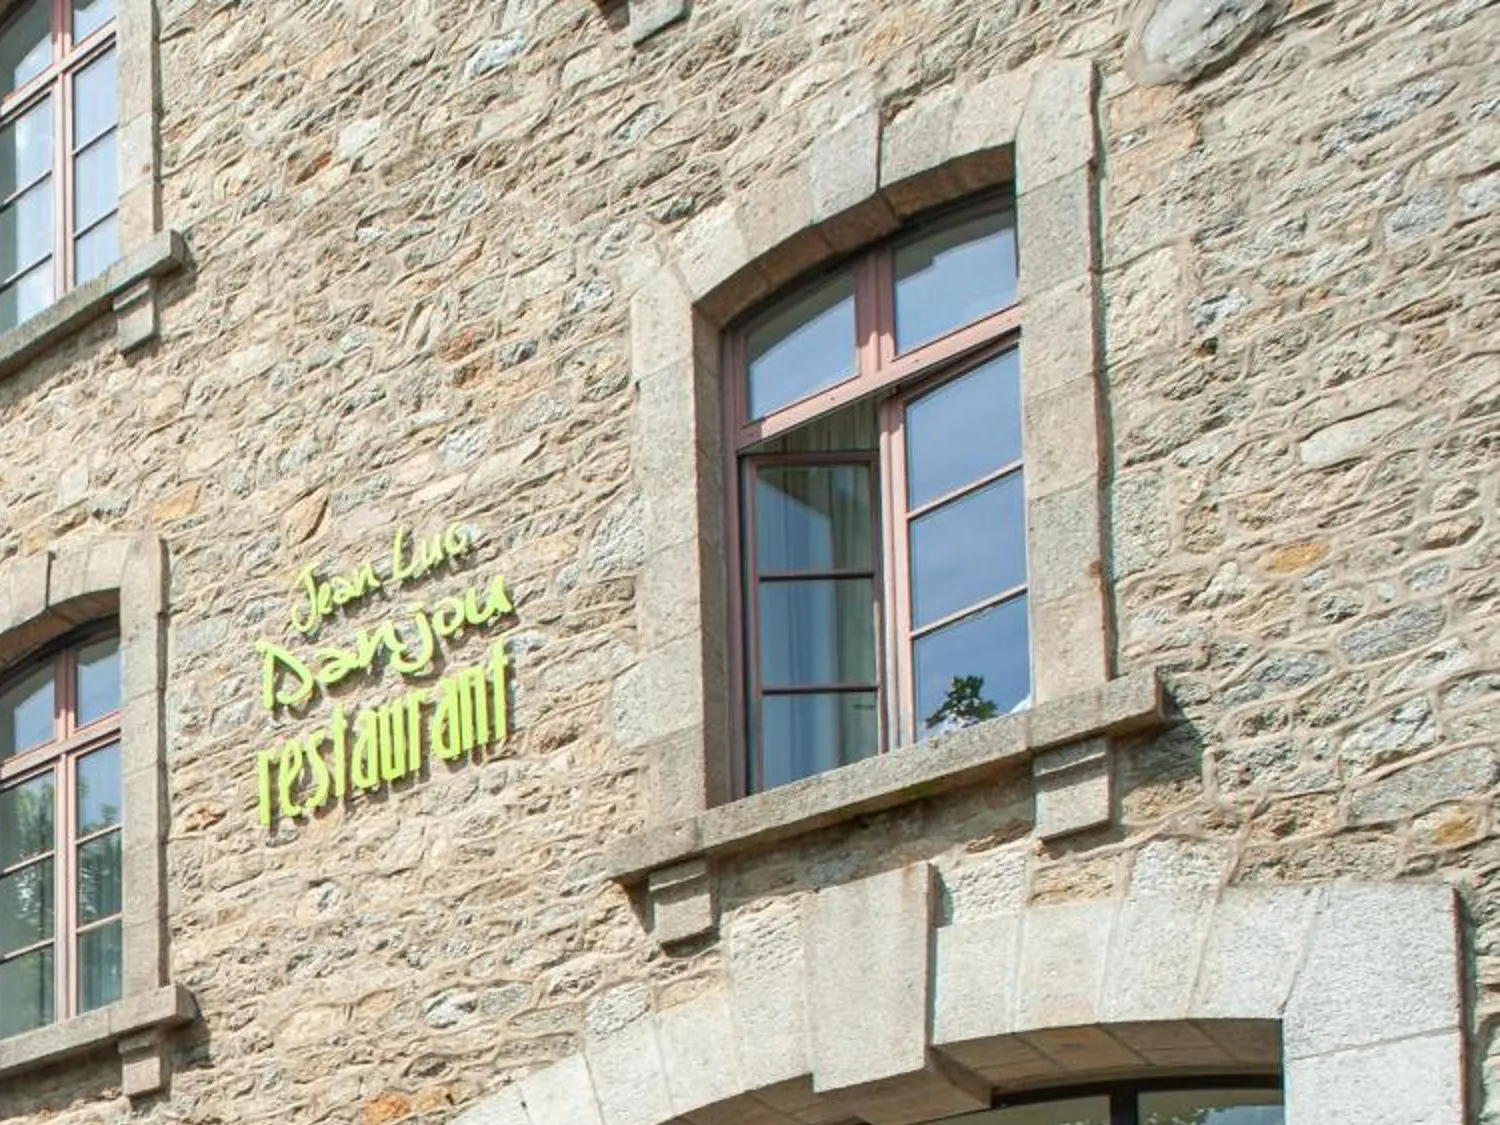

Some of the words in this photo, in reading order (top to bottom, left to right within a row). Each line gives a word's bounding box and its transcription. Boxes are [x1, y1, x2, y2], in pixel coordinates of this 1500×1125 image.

[256, 575, 514, 711] Danjou
[291, 562, 381, 633] Jean
[258, 638, 510, 827] restaurant
